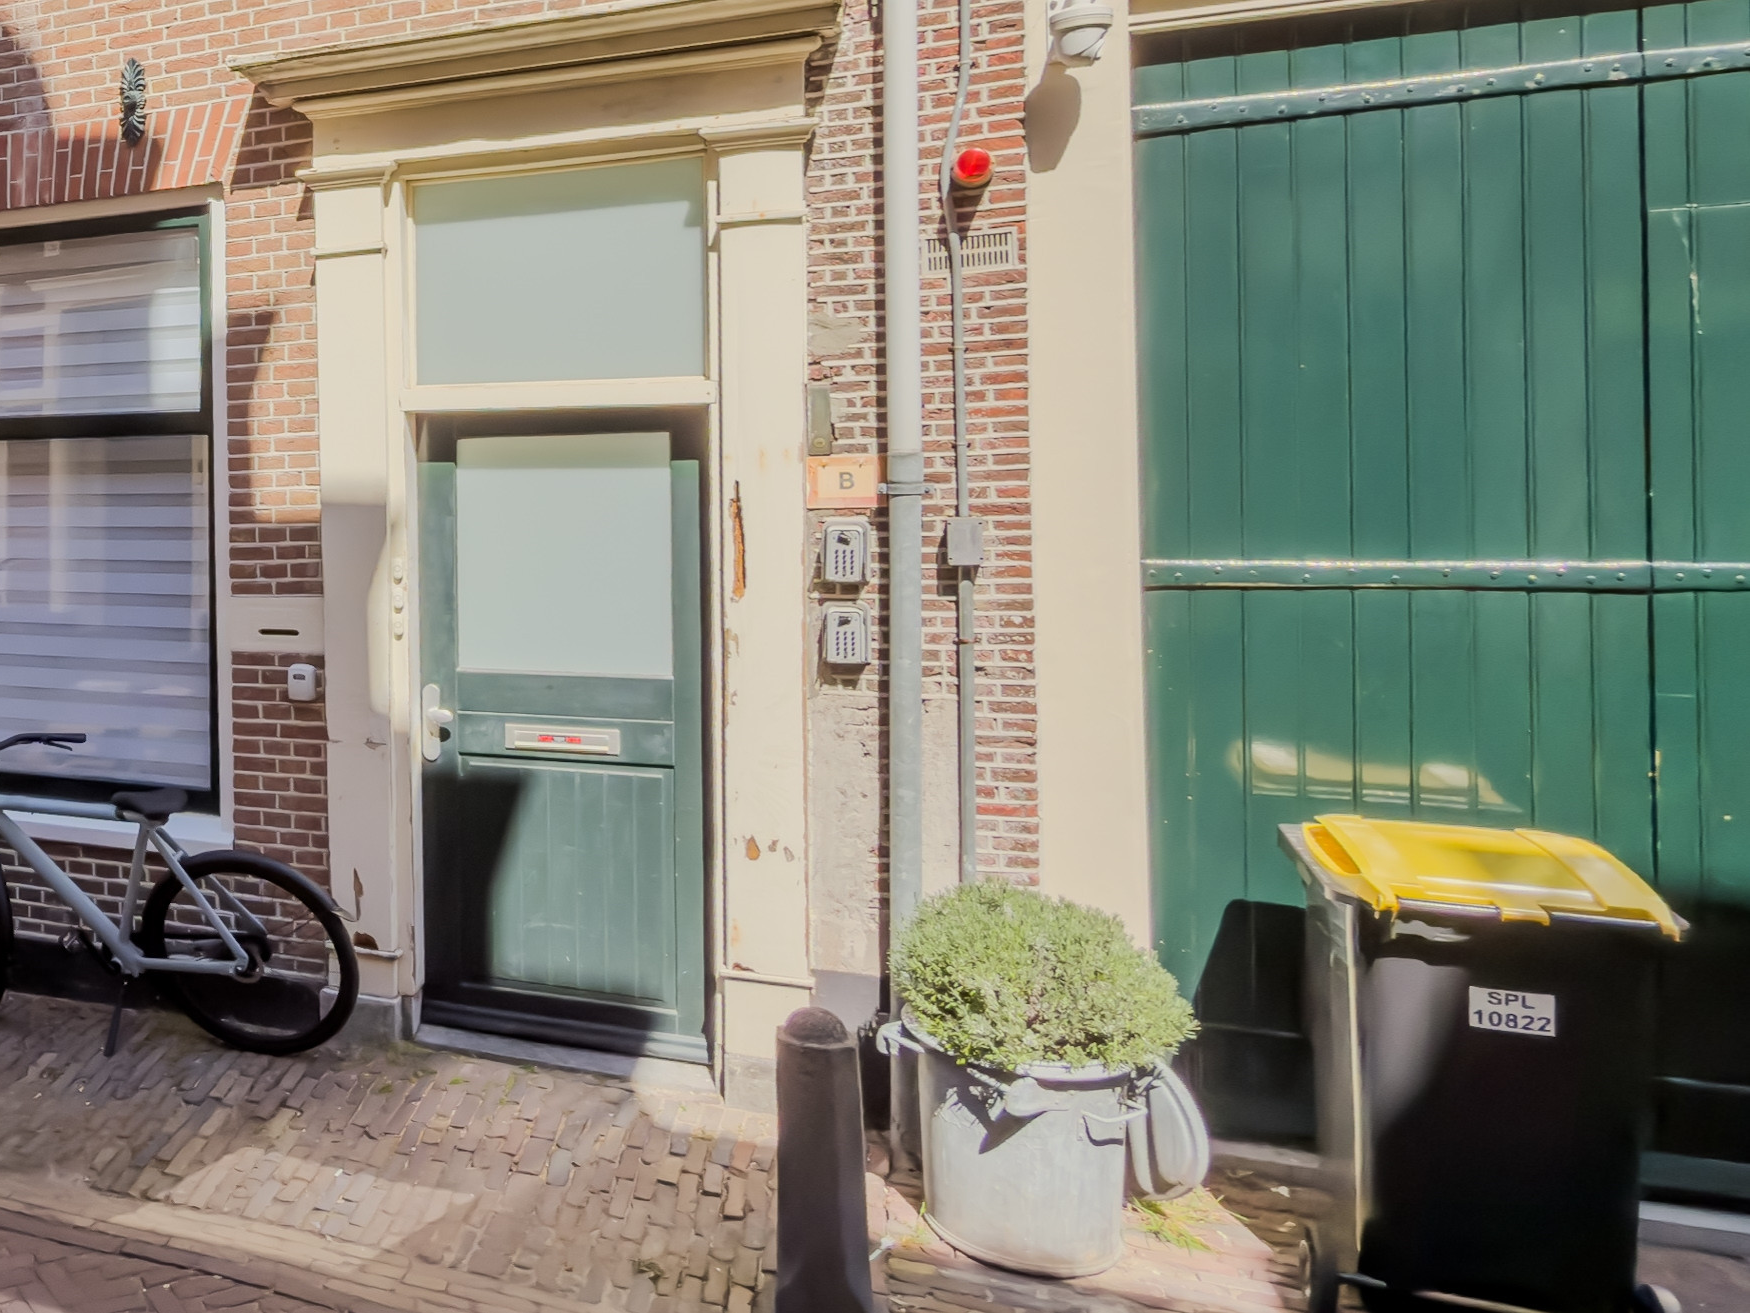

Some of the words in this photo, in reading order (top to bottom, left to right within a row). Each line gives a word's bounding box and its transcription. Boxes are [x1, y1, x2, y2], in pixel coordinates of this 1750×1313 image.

[838, 471, 855, 490] B
[1487, 991, 1535, 1010] SPL
[1473, 1010, 1551, 1032] 10822
